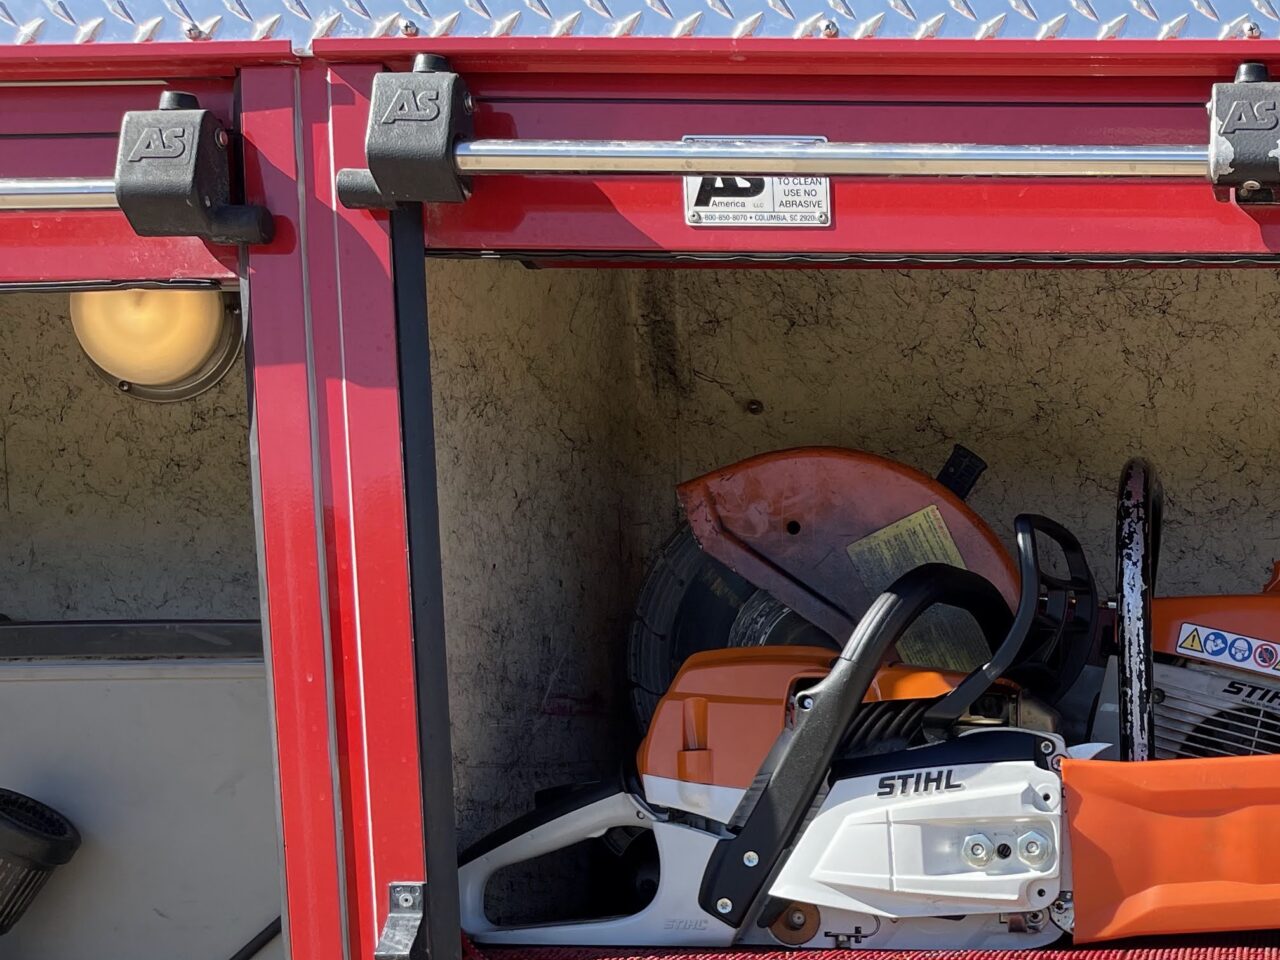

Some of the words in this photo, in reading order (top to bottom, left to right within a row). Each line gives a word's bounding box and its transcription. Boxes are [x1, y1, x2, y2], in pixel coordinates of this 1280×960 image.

[381, 88, 440, 125] AS
[1219, 100, 1279, 134] AS
[128, 127, 187, 162] AS
[778, 177, 790, 186] TO
[792, 177, 822, 186] CLEAN
[783, 189, 801, 197] USE
[803, 189, 817, 197] NO
[711, 199, 746, 208] America
[778, 200, 823, 208] ABRASIVE
[700, 214, 748, 222] -800-850-8070
[877, 768, 962, 797] STIHL
